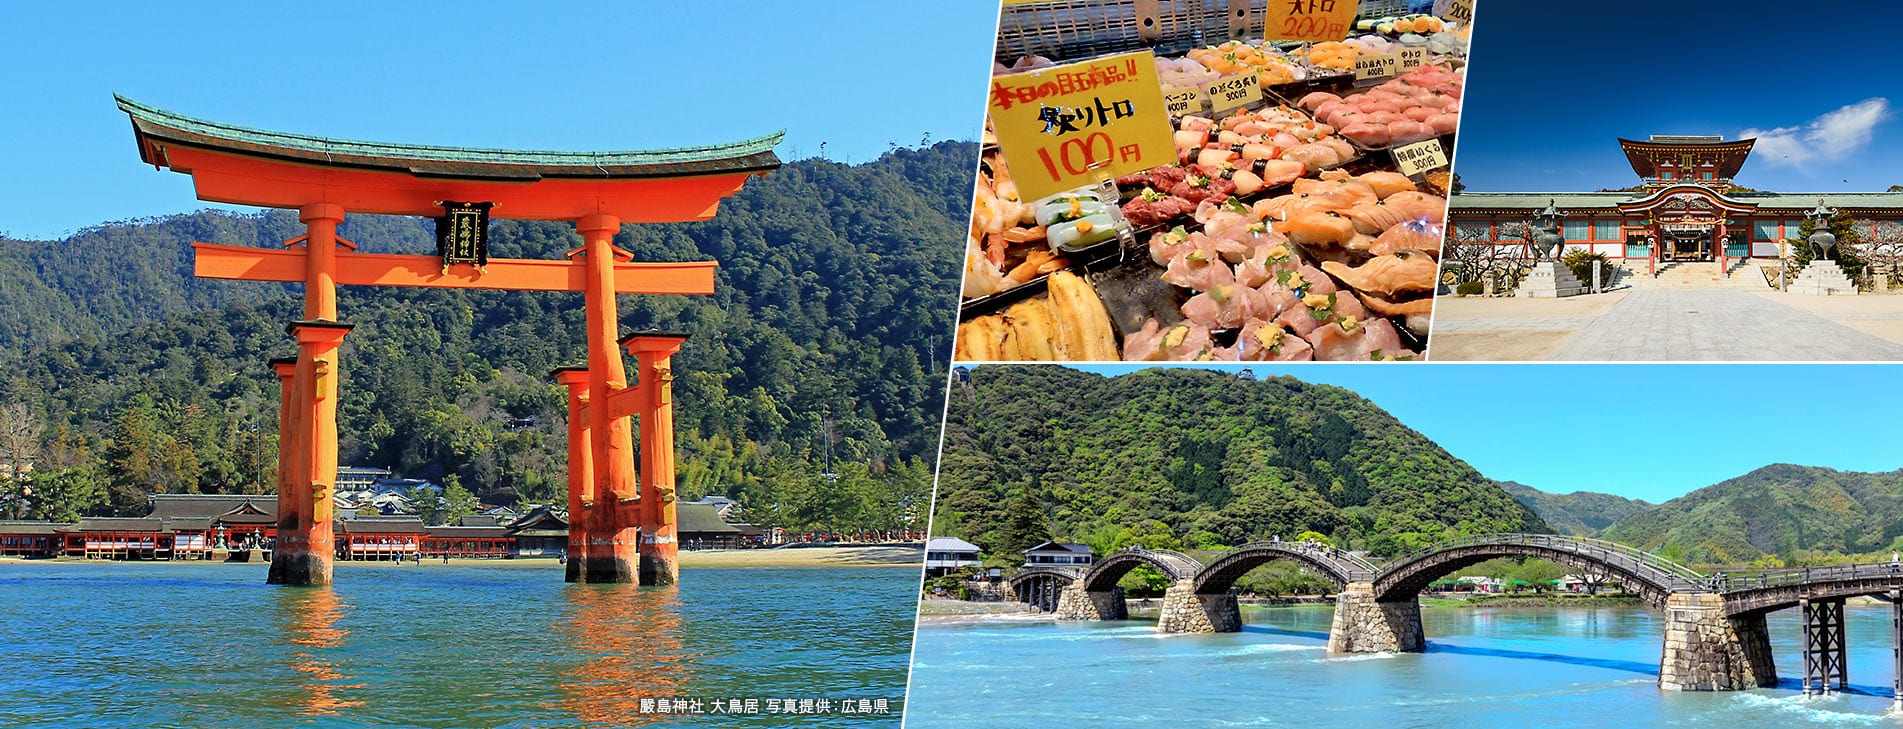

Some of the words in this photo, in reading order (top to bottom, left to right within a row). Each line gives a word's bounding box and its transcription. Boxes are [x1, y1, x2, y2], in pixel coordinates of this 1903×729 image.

[1288, 0, 1336, 15] 大トロ
[1281, 16, 1344, 38] 200円
[1037, 132, 1142, 183] 100円
